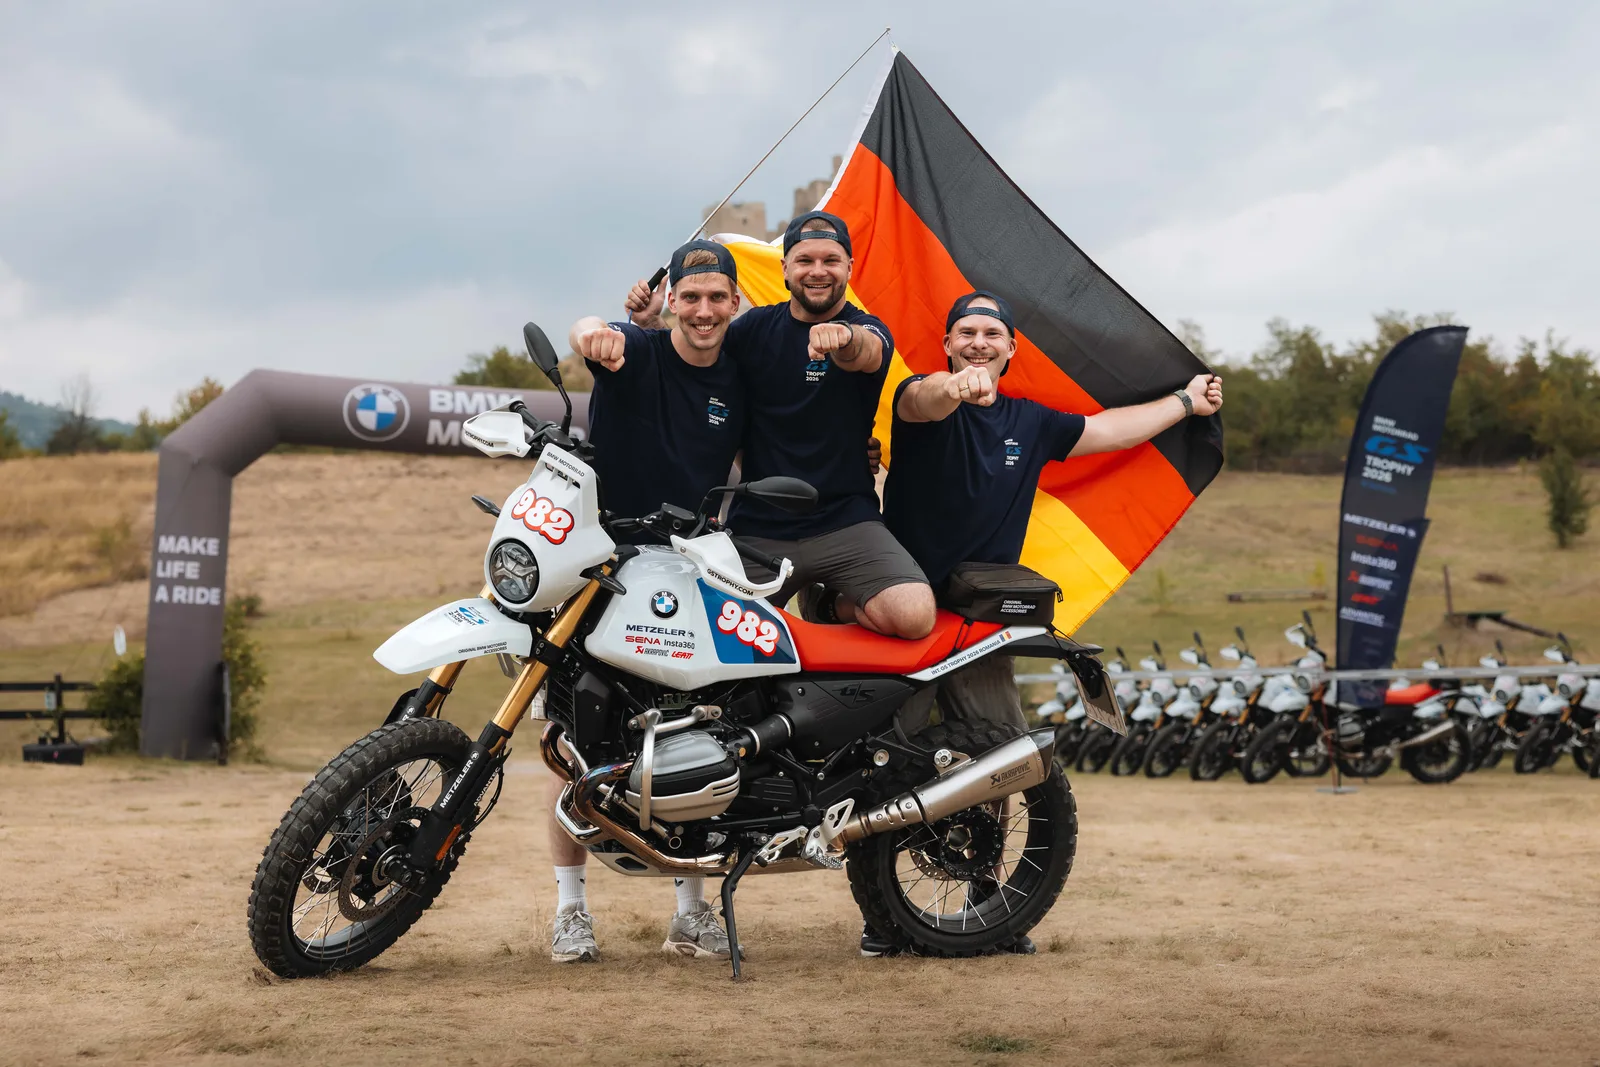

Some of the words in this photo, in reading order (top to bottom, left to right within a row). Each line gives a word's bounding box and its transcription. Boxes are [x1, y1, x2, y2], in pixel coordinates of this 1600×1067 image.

[1364, 435, 1430, 464] GS
[546, 451, 560, 461] BMW
[558, 458, 585, 478] MOTORRAD
[1362, 466, 1392, 483] 2026
[1365, 454, 1415, 476] TROPHY
[511, 487, 575, 545] 982
[1343, 513, 1407, 536] METZELER
[158, 535, 220, 556] MAKE
[156, 559, 200, 580] LIFE
[706, 568, 754, 596] GSTROPHY.COM
[155, 584, 169, 603] A
[172, 584, 221, 606] RIDE
[625, 624, 686, 637] METZELER
[716, 600, 780, 657] 982
[625, 635, 661, 645] SENA
[664, 639, 696, 650] Insta360
[947, 656, 967, 668] TROPHY
[966, 649, 980, 659] 2026
[979, 639, 1001, 653] ROMANIA
[671, 650, 694, 660] LEATT
[440, 759, 474, 809] METZELER
